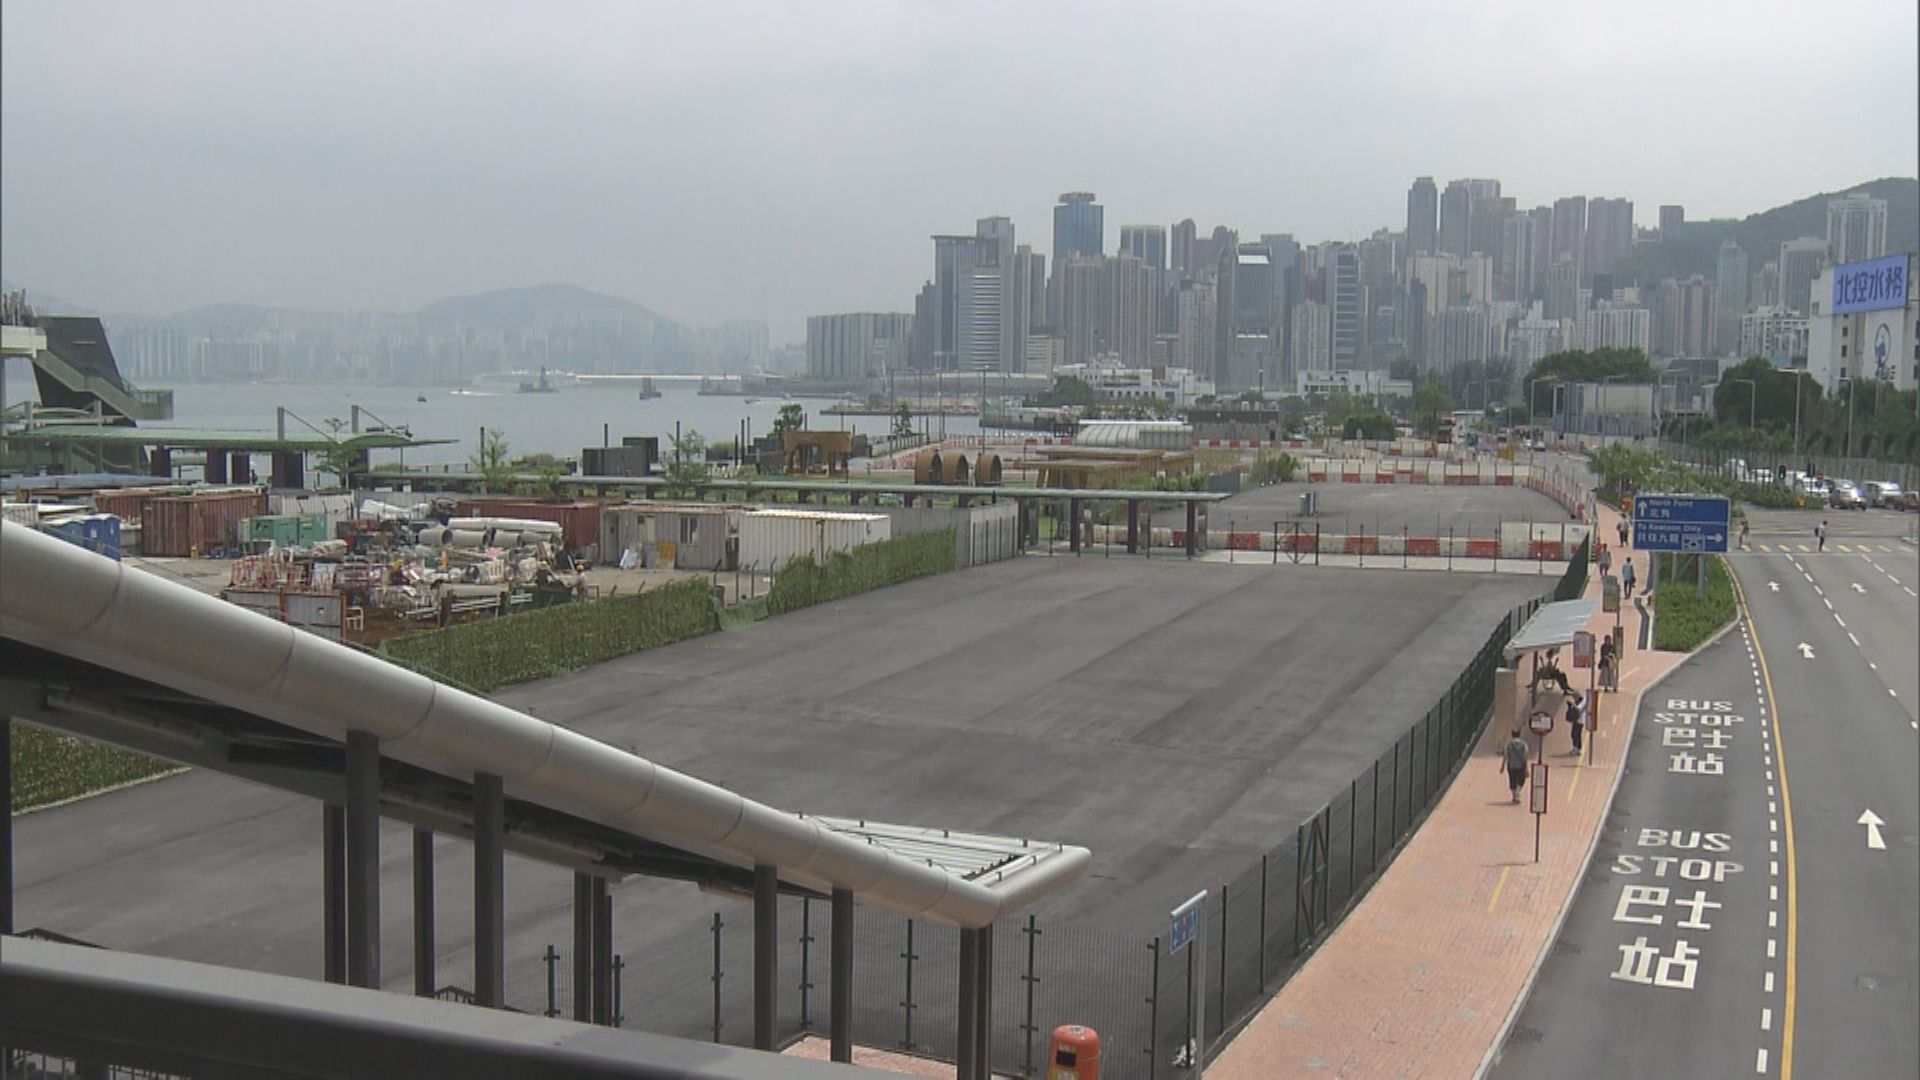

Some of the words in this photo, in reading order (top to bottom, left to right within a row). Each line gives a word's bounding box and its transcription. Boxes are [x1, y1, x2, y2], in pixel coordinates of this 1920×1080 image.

[1836, 265, 1902, 305] 北控水務
[1683, 525, 1701, 533] Only
[1667, 699, 1733, 711] BUS
[1654, 712, 1744, 726] STOP
[1662, 727, 1733, 748] 巴士
[1668, 751, 1723, 775] 站
[1637, 828, 1731, 851] BUS
[1611, 855, 1744, 882] STOP
[1613, 885, 1722, 929] 巴士
[1610, 936, 1700, 989] 站
